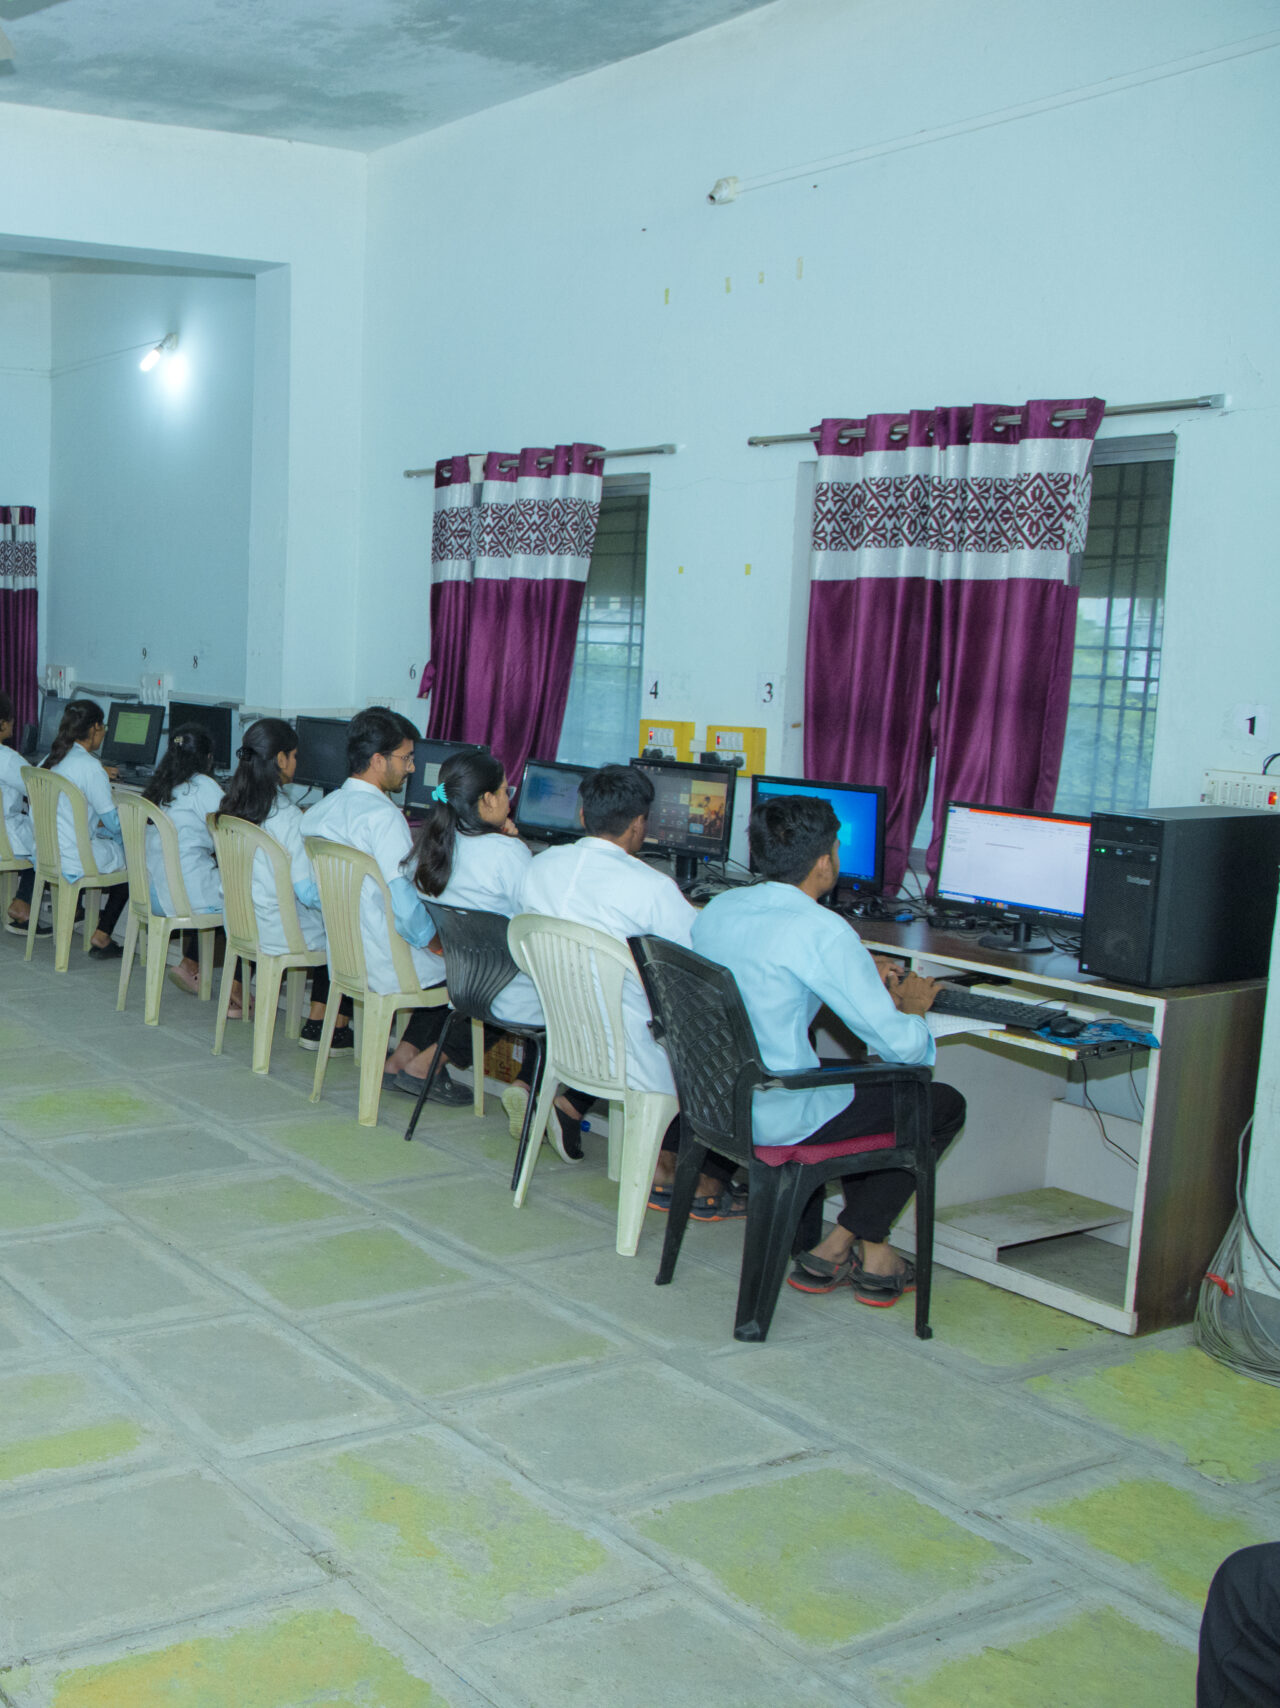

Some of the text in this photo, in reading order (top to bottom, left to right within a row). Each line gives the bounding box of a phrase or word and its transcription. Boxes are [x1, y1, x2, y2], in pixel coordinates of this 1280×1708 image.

[142, 647, 147, 660] 9
[193, 655, 198, 669] 8
[409, 663, 416, 680] 6
[649, 680, 658, 699] 4
[762, 682, 773, 703] 3
[1245, 715, 1256, 736] 1
